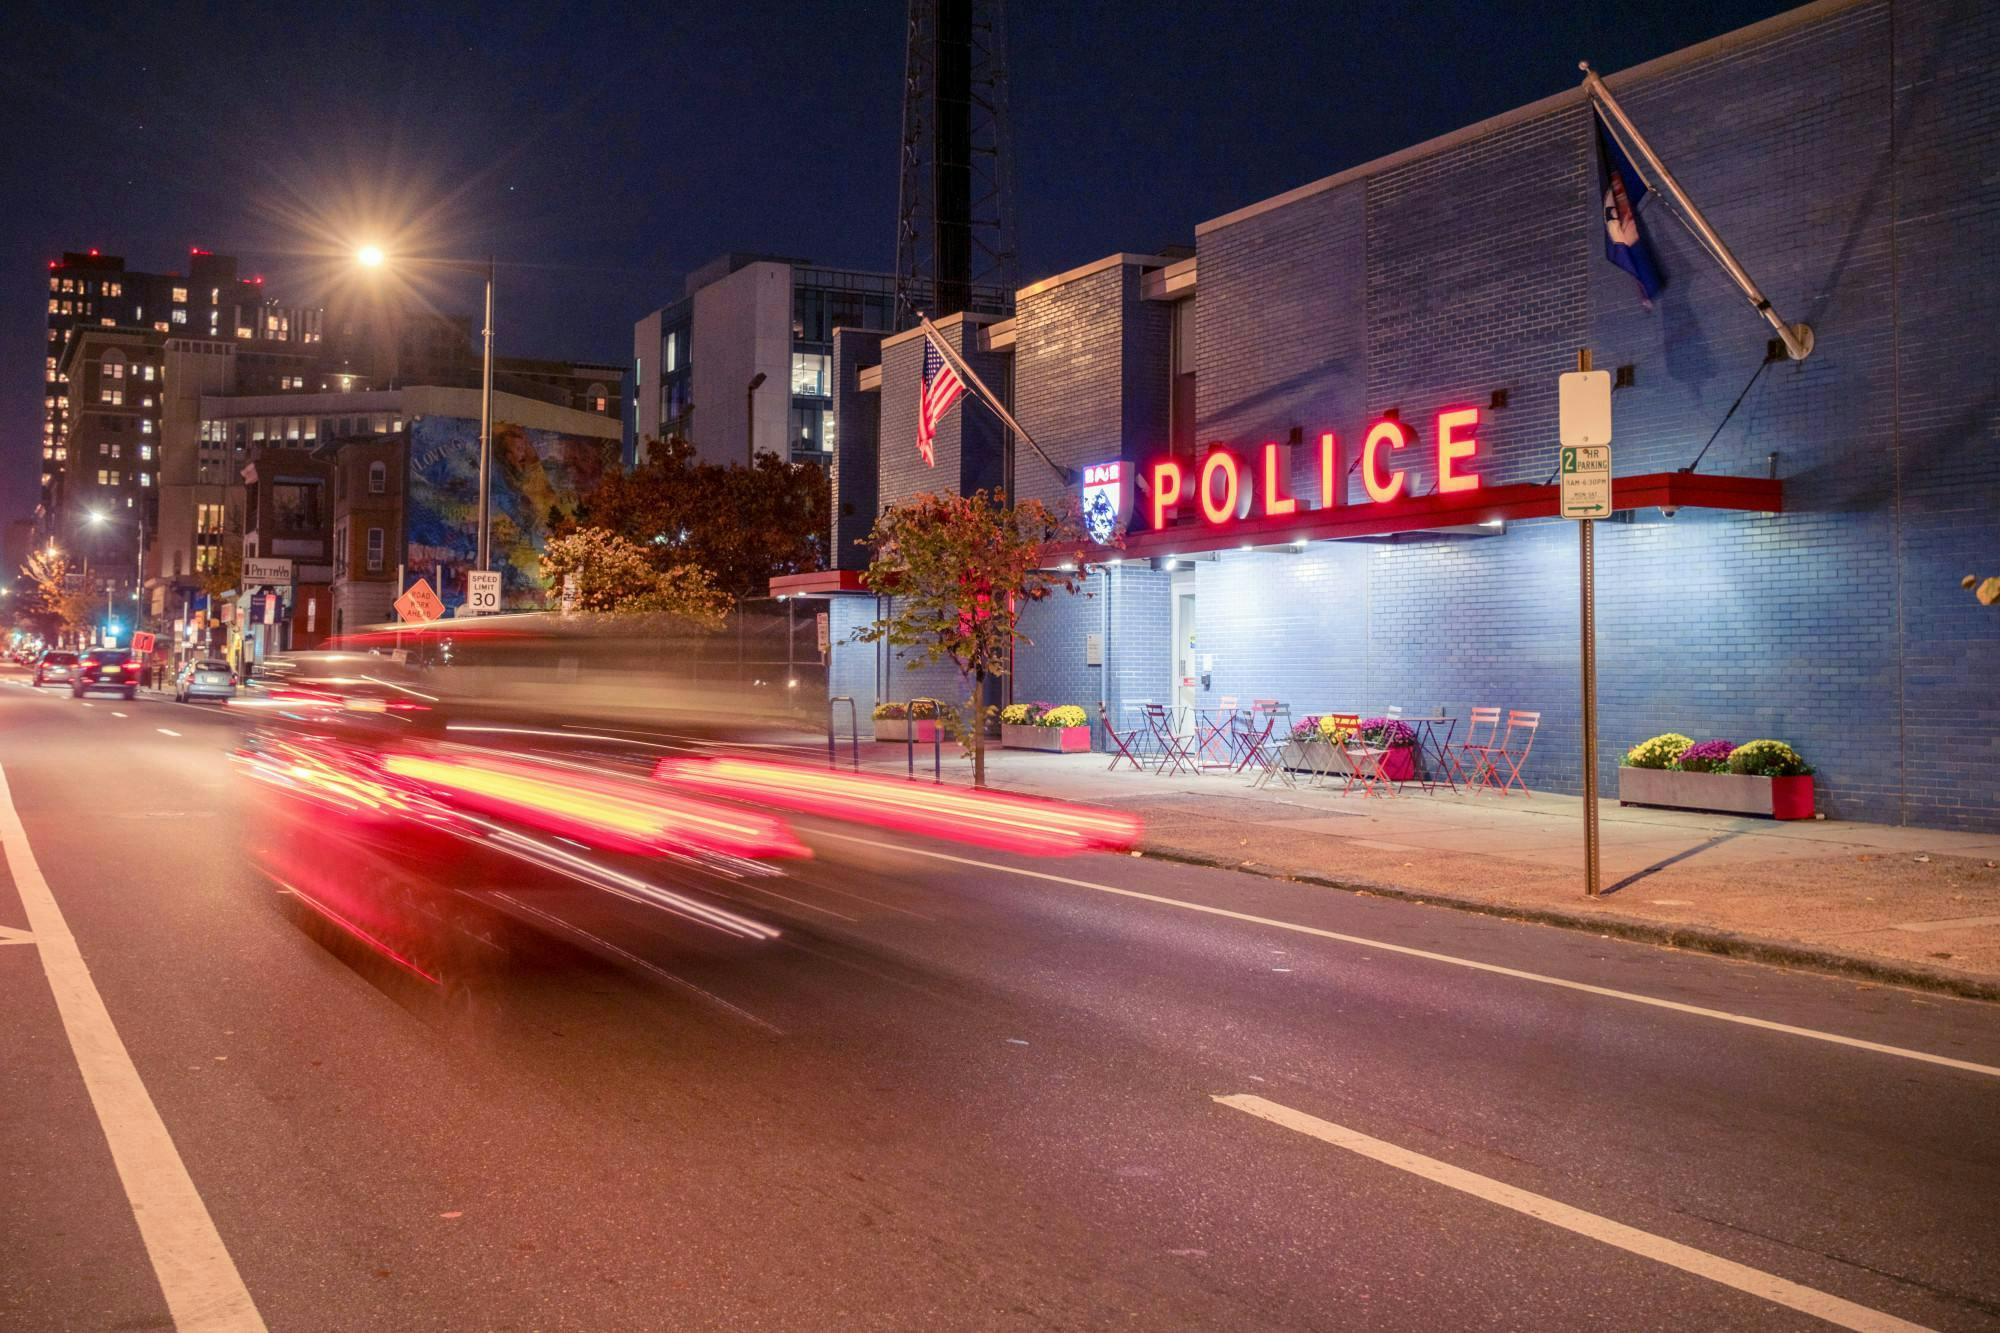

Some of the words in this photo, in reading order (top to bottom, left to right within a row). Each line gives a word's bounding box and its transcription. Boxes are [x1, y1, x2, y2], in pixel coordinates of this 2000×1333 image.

[1565, 451, 1574, 470] 2
[1587, 449, 1599, 459] HR
[1577, 460, 1608, 470] PARKING
[1155, 408, 1479, 530] POLICE
[472, 575, 498, 583] SPEED
[473, 592, 496, 607] 30
